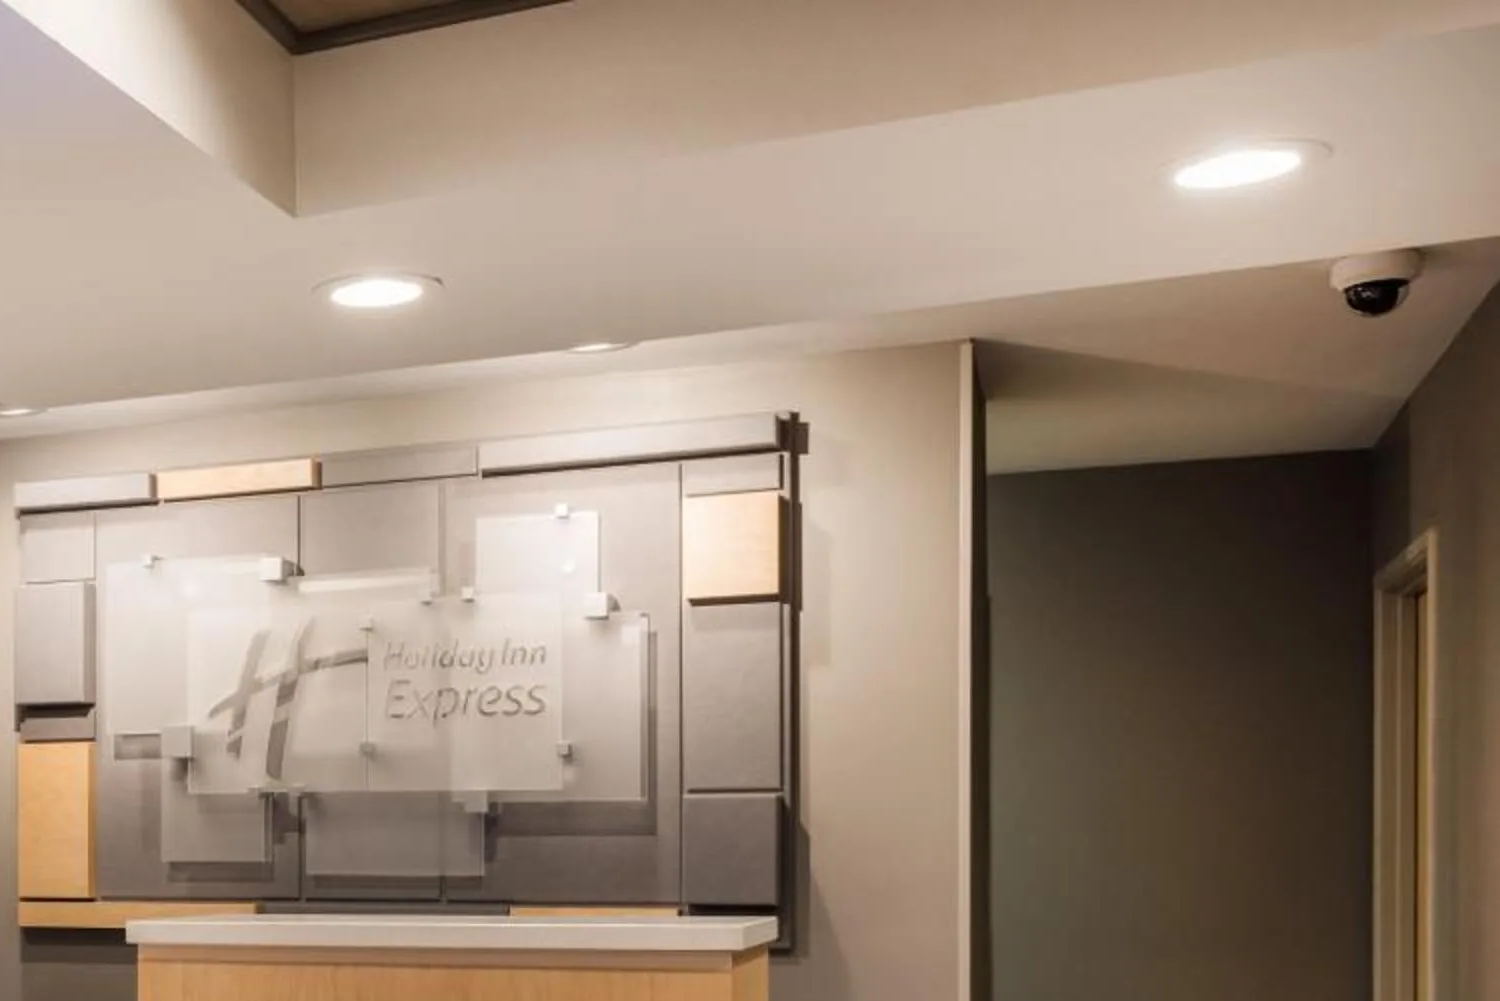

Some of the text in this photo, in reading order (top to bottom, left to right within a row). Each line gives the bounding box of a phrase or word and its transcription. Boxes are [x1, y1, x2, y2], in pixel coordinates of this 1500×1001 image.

[383, 636, 547, 675] Holiday Inn
[385, 679, 547, 728] Express
